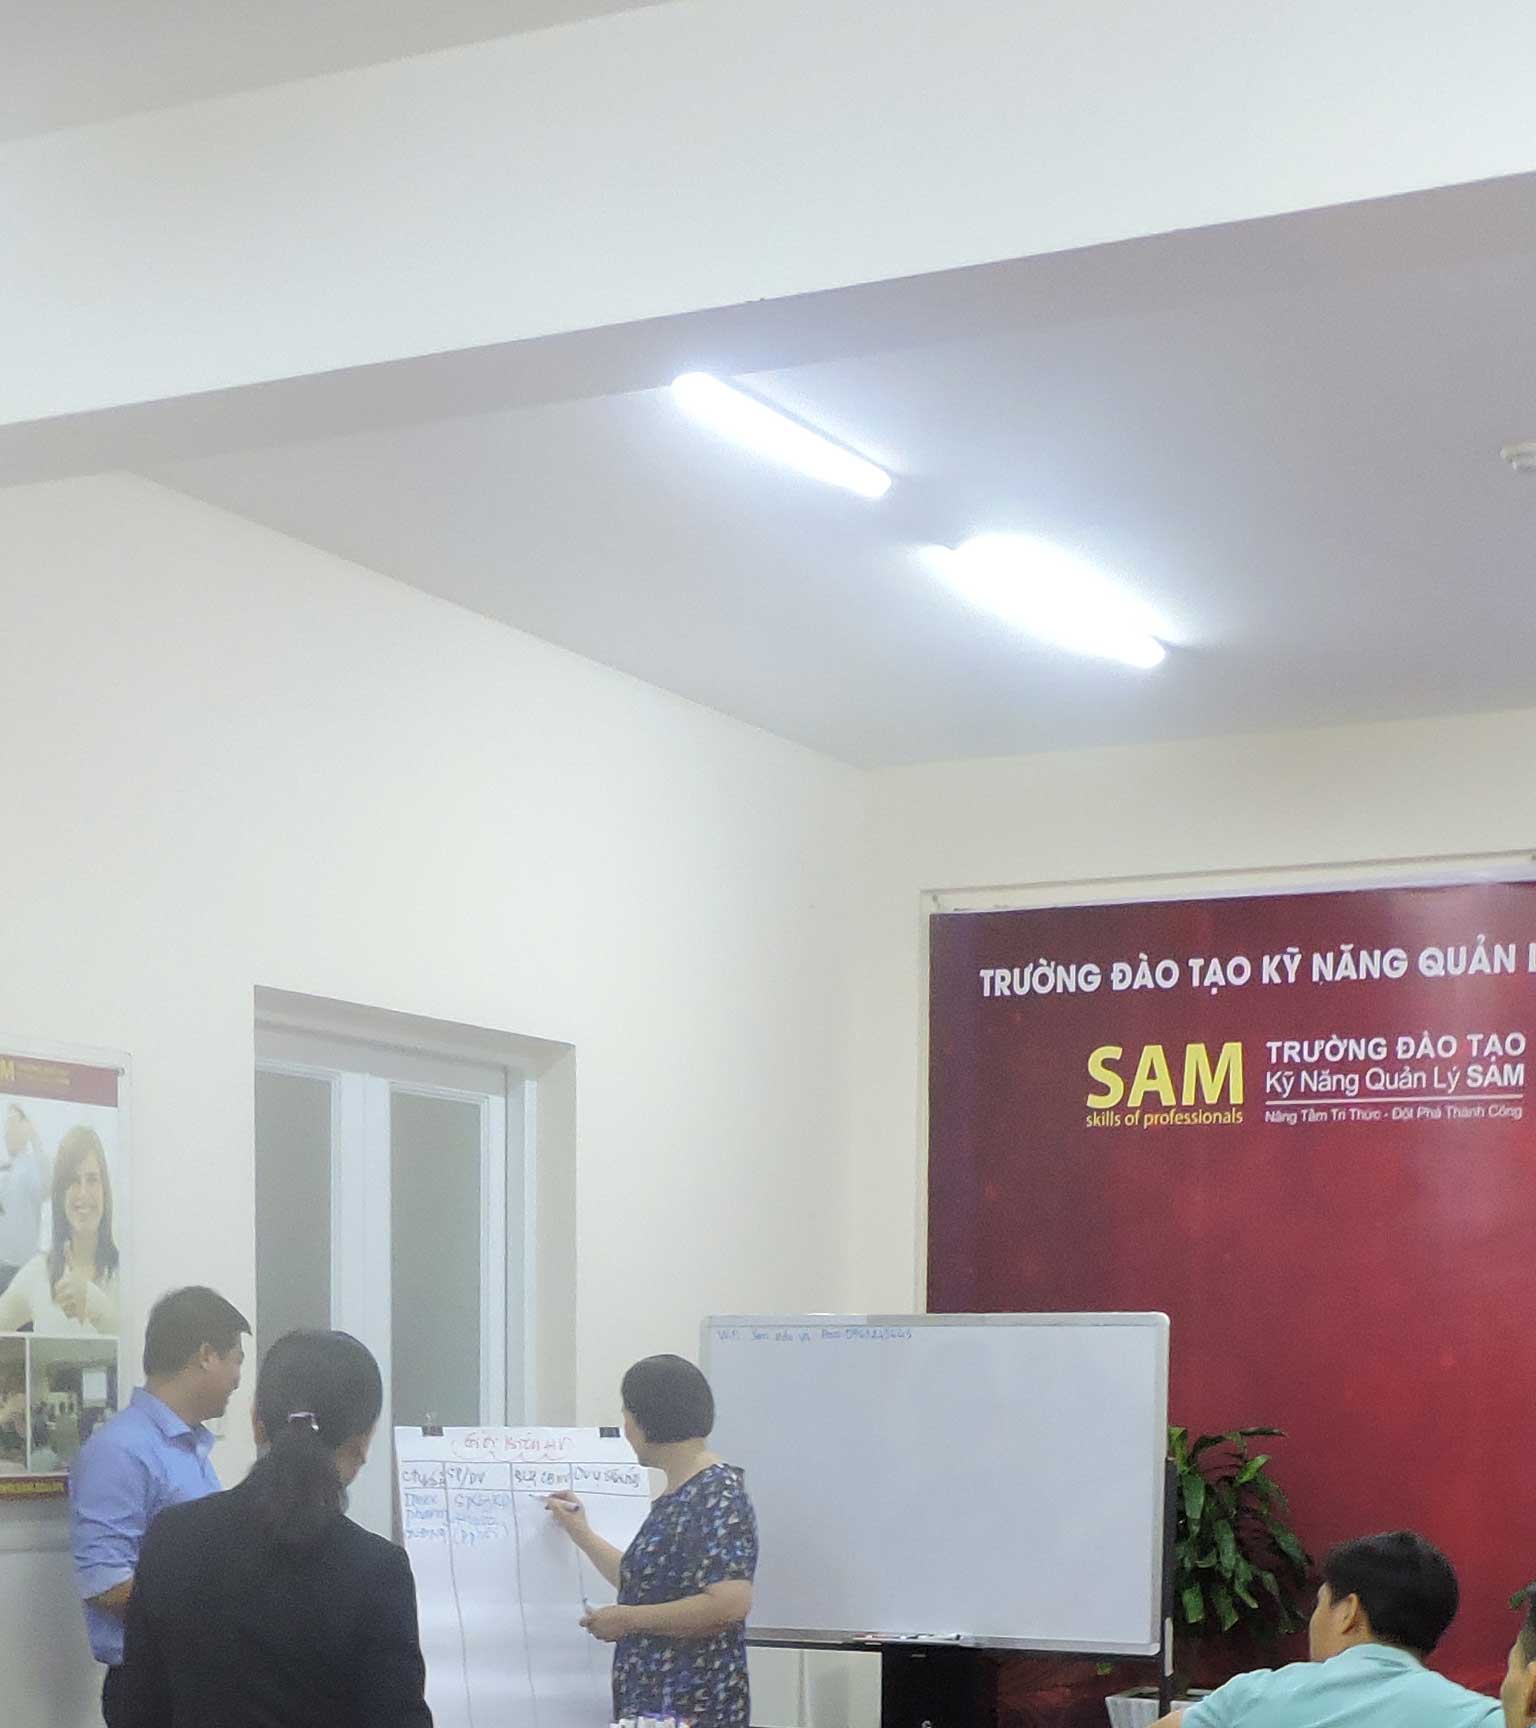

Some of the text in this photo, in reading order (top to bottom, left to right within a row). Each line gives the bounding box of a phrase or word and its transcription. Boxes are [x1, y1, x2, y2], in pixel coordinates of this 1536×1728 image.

[979, 957, 1102, 997] TRƯỜNG
[1110, 952, 1180, 991] ĐÀO
[1187, 955, 1252, 995] TẠO
[1261, 946, 1302, 984] KỸ
[1311, 943, 1409, 983] NĂNG
[1417, 933, 1516, 978] QUẢN
[1265, 1030, 1526, 1065] TRƯỜNG ĐÀO TẠO
[1086, 1041, 1244, 1109] SAM
[1265, 1062, 1525, 1098] Kỹ Năng Quản Lý SAM
[1085, 1107, 1244, 1130] skills of professionals
